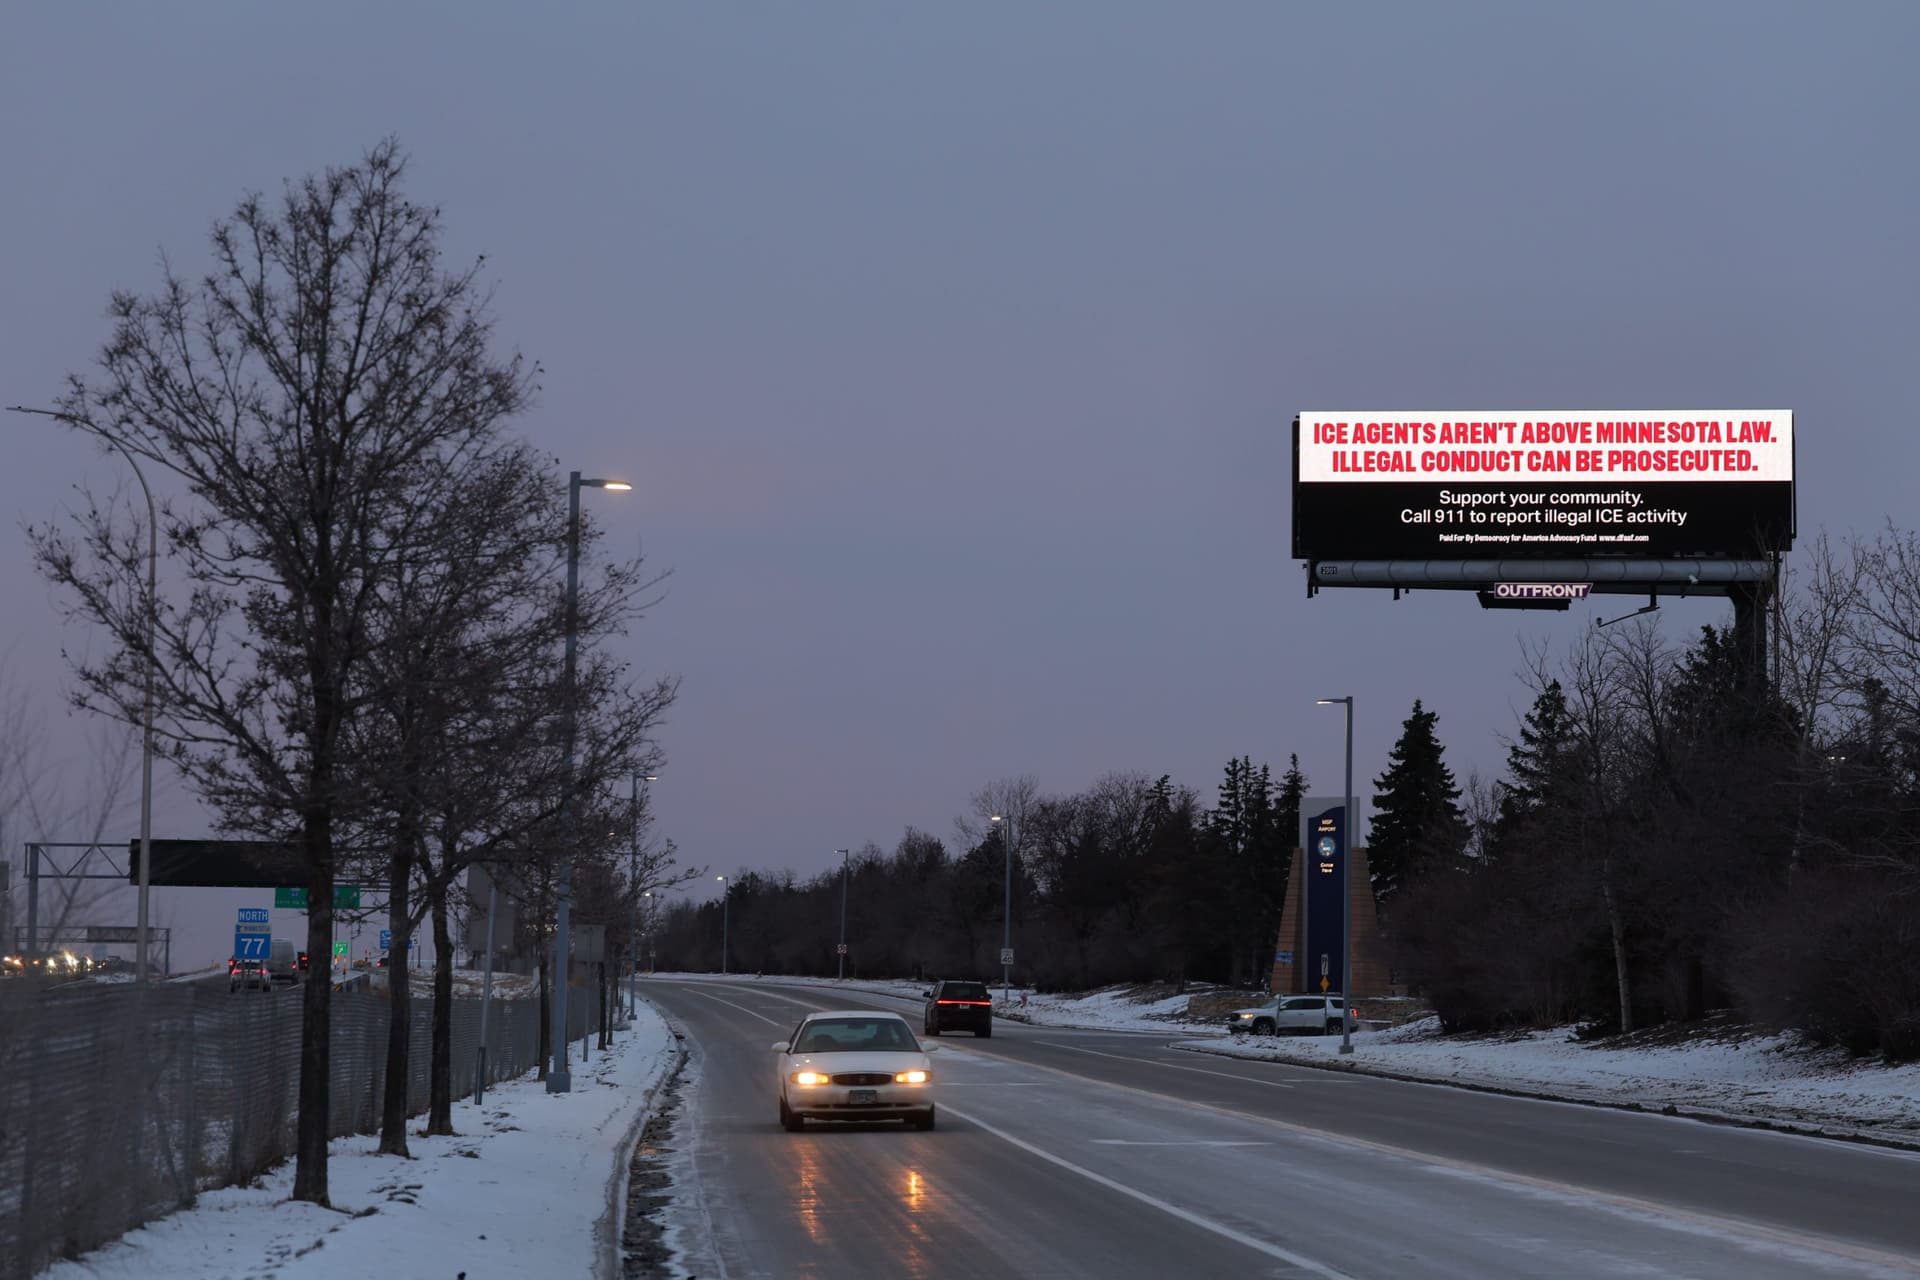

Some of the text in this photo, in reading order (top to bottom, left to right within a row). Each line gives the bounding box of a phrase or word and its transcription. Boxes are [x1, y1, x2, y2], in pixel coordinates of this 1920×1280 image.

[1313, 421, 1777, 444] ICE AGENTS AREN'T ABOVE MINNESOTA LAW.
[1332, 450, 1758, 472] ILLEGAL CONDUCT CAN BE PROSECUTED.
[1439, 490, 1644, 507] Support your community.
[1401, 509, 1687, 526] Call 911 to report illegal ICE activity
[1497, 584, 1588, 597] OUTFRONT
[239, 911, 268, 921] NORTH
[240, 938, 265, 955] 77
